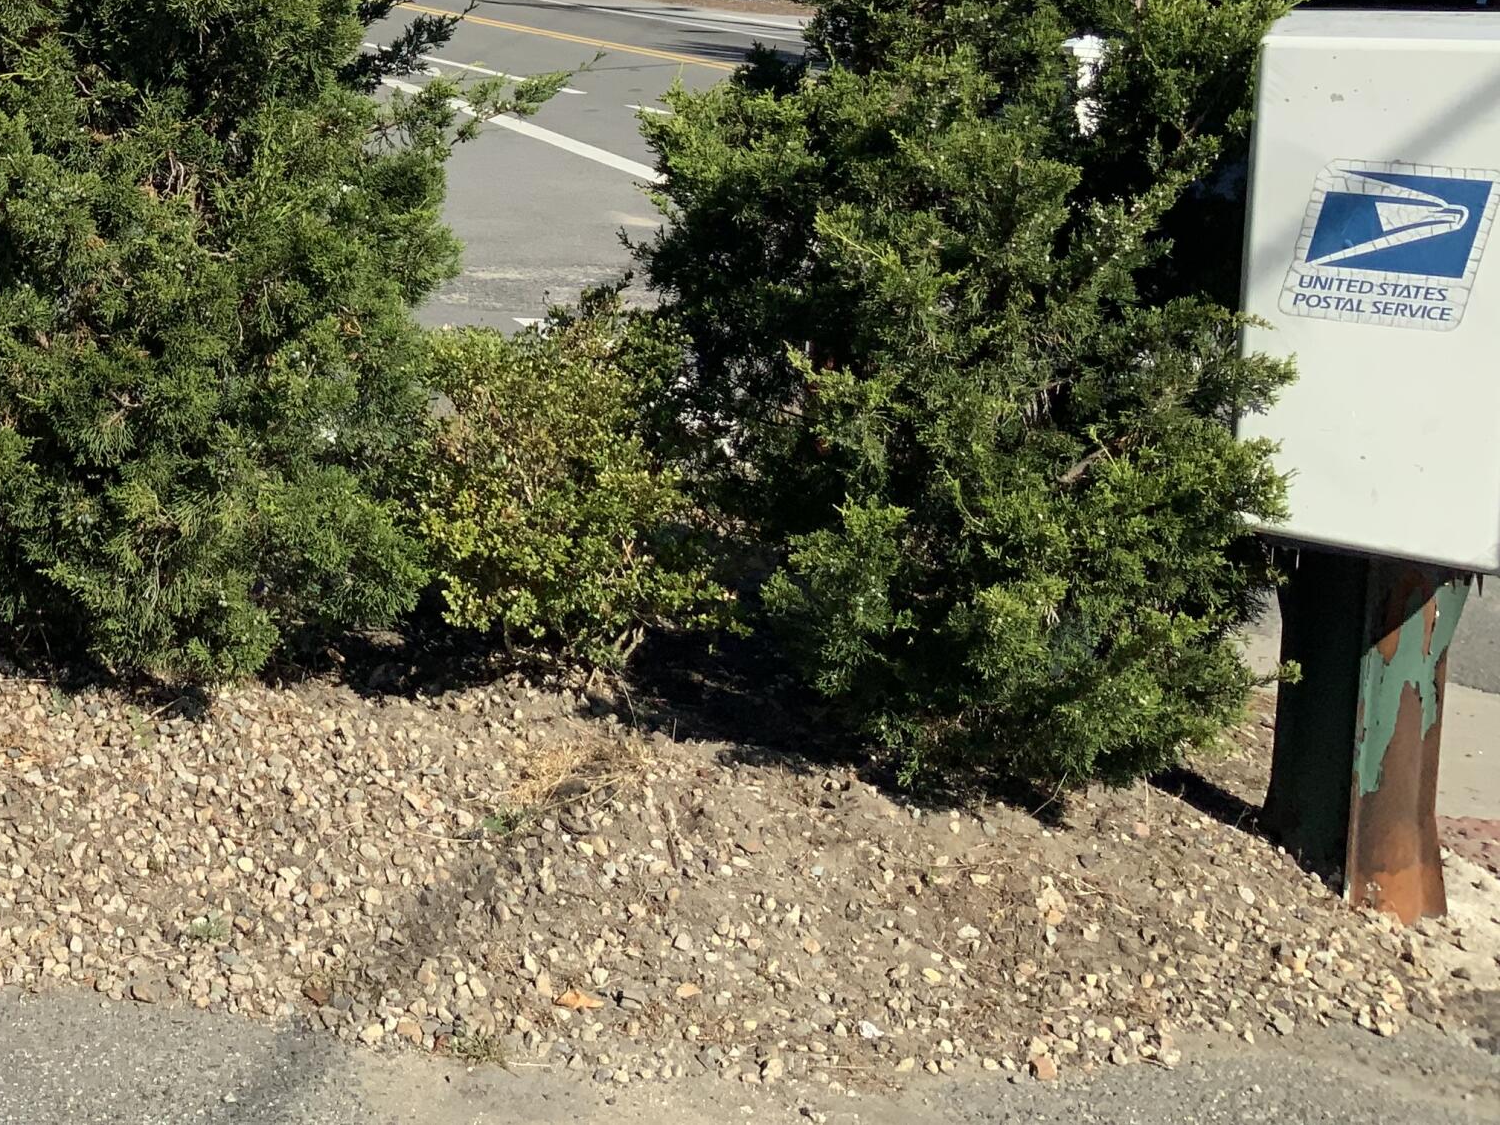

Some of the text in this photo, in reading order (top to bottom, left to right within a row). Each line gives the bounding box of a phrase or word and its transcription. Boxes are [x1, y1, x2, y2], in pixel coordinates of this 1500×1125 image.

[1299, 275, 1449, 302] UNITED STATES
[1293, 293, 1453, 321] POSTAL SERVICE
